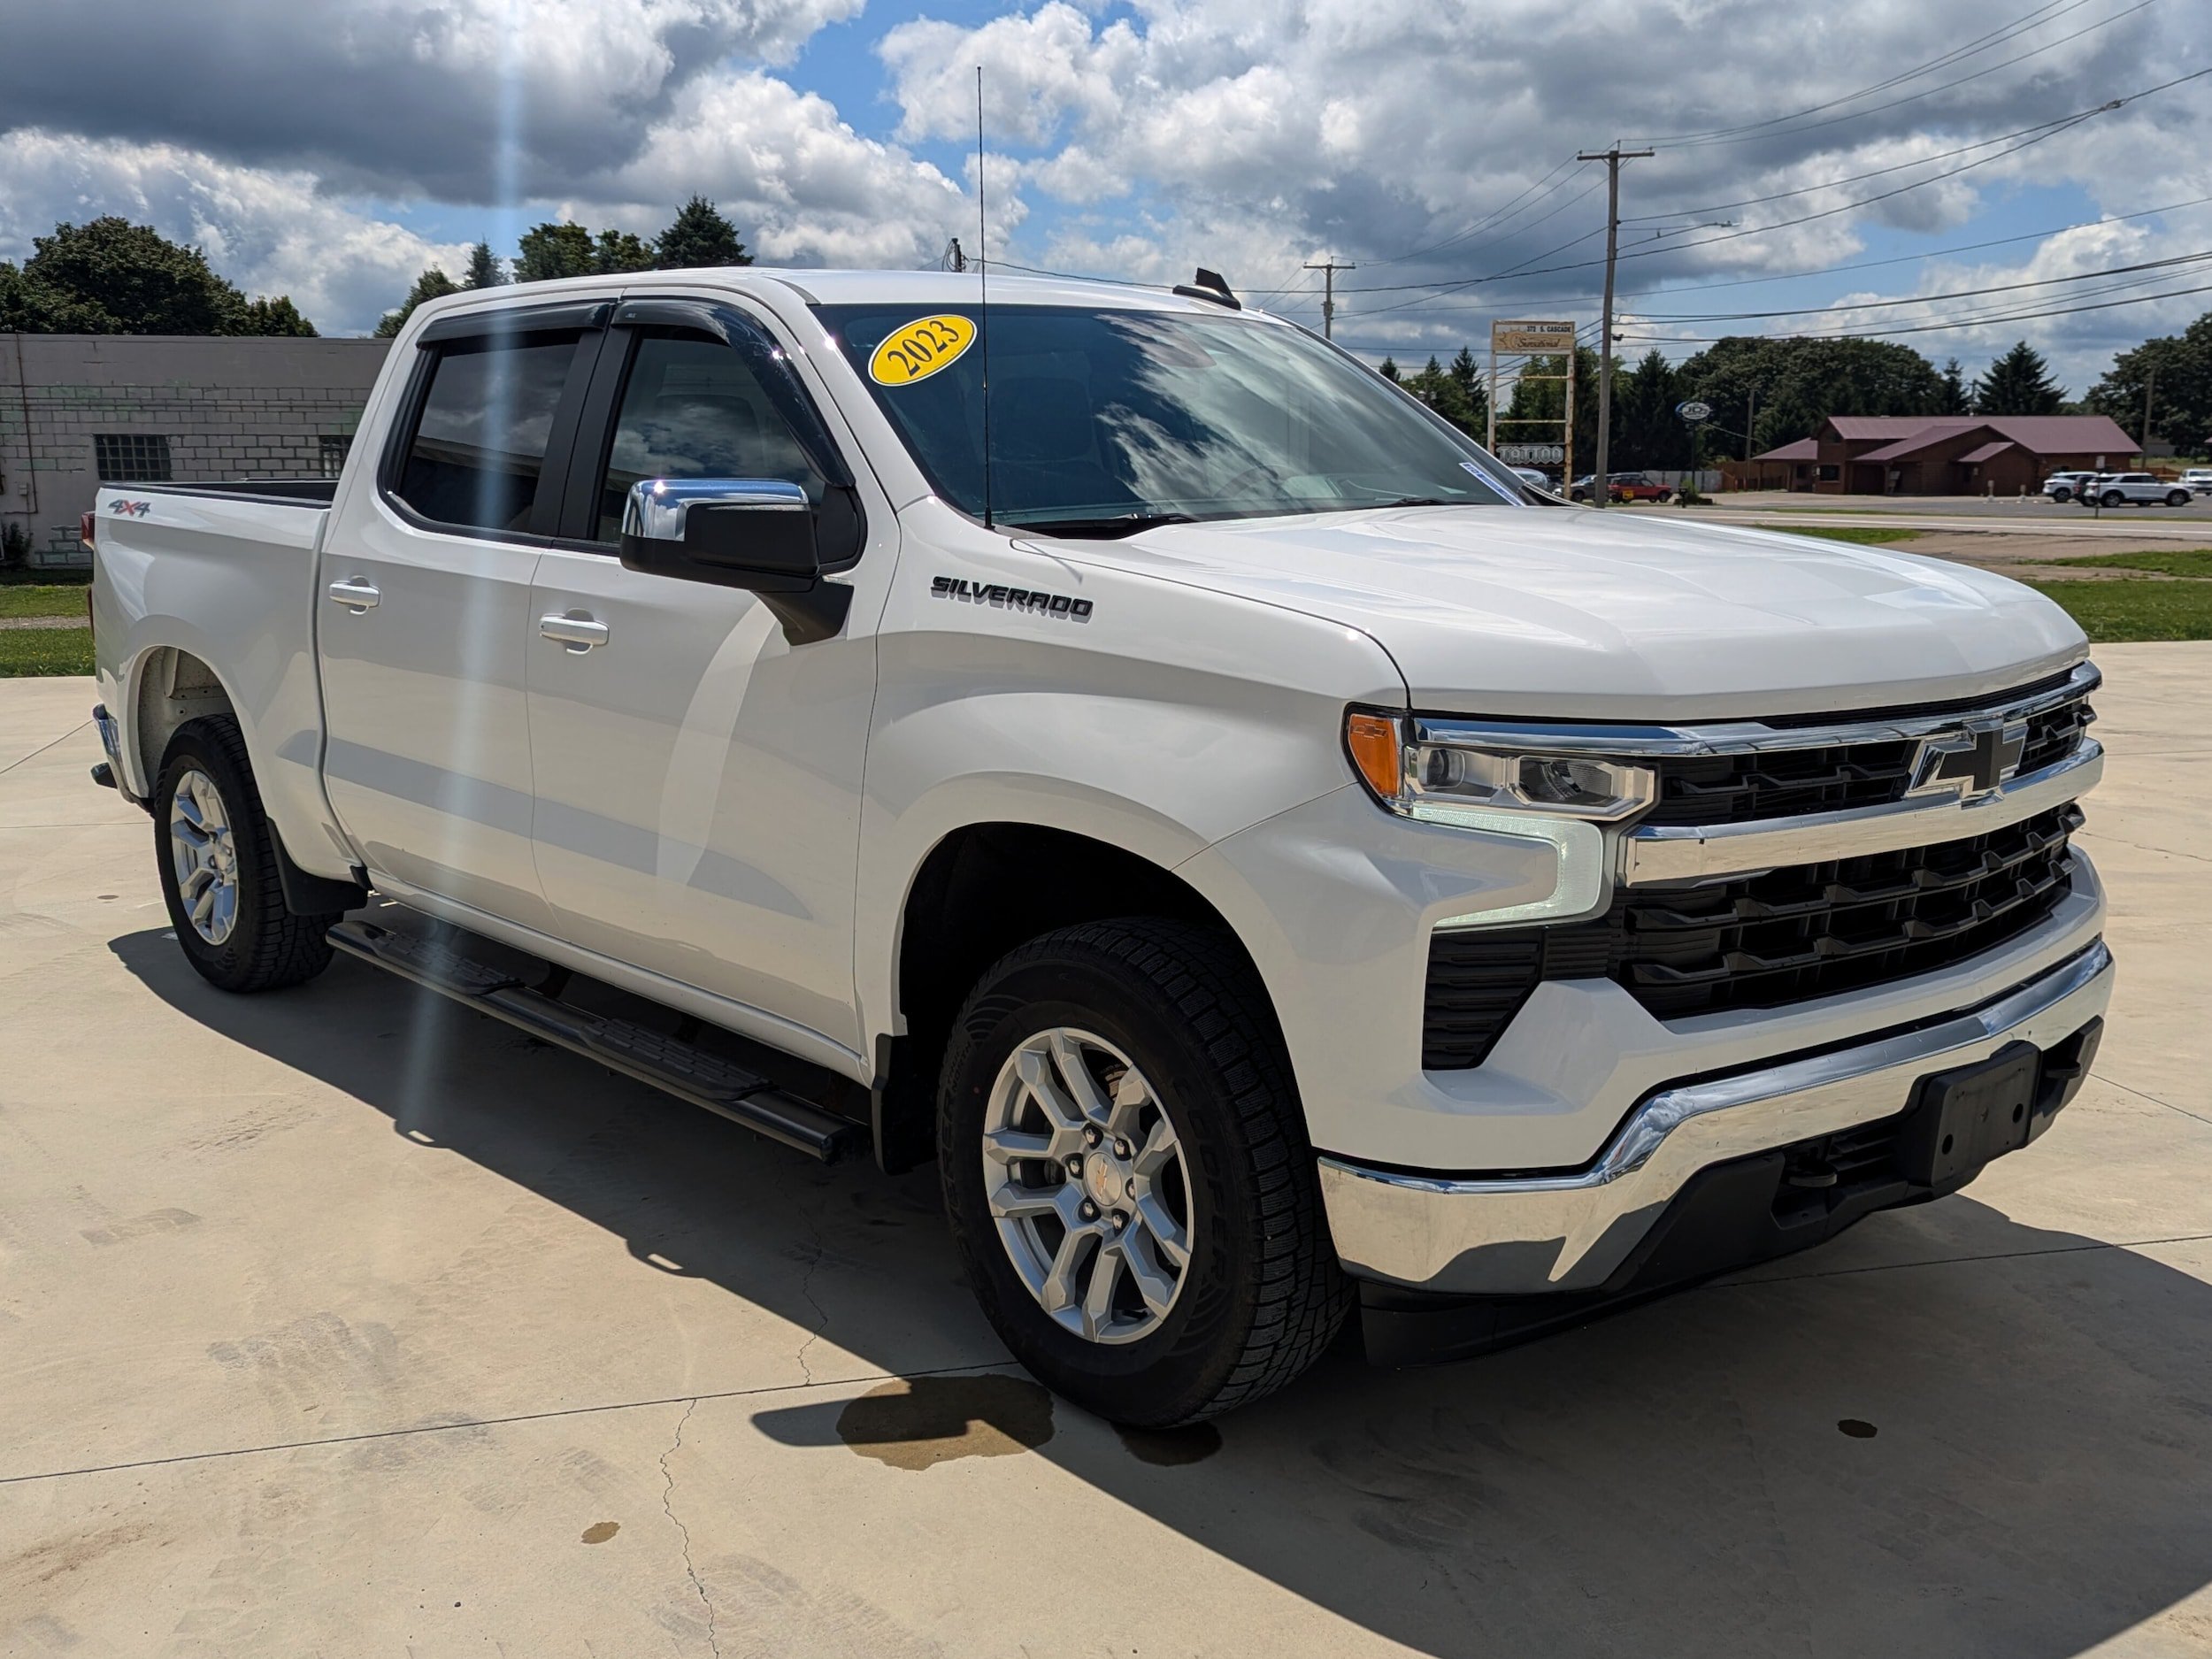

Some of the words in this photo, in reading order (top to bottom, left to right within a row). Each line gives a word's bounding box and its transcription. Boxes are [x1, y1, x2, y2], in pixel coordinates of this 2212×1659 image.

[887, 320, 959, 377] 2023
[1495, 445, 1564, 465] TATTOO
[930, 576, 1094, 618] SILVERADO
